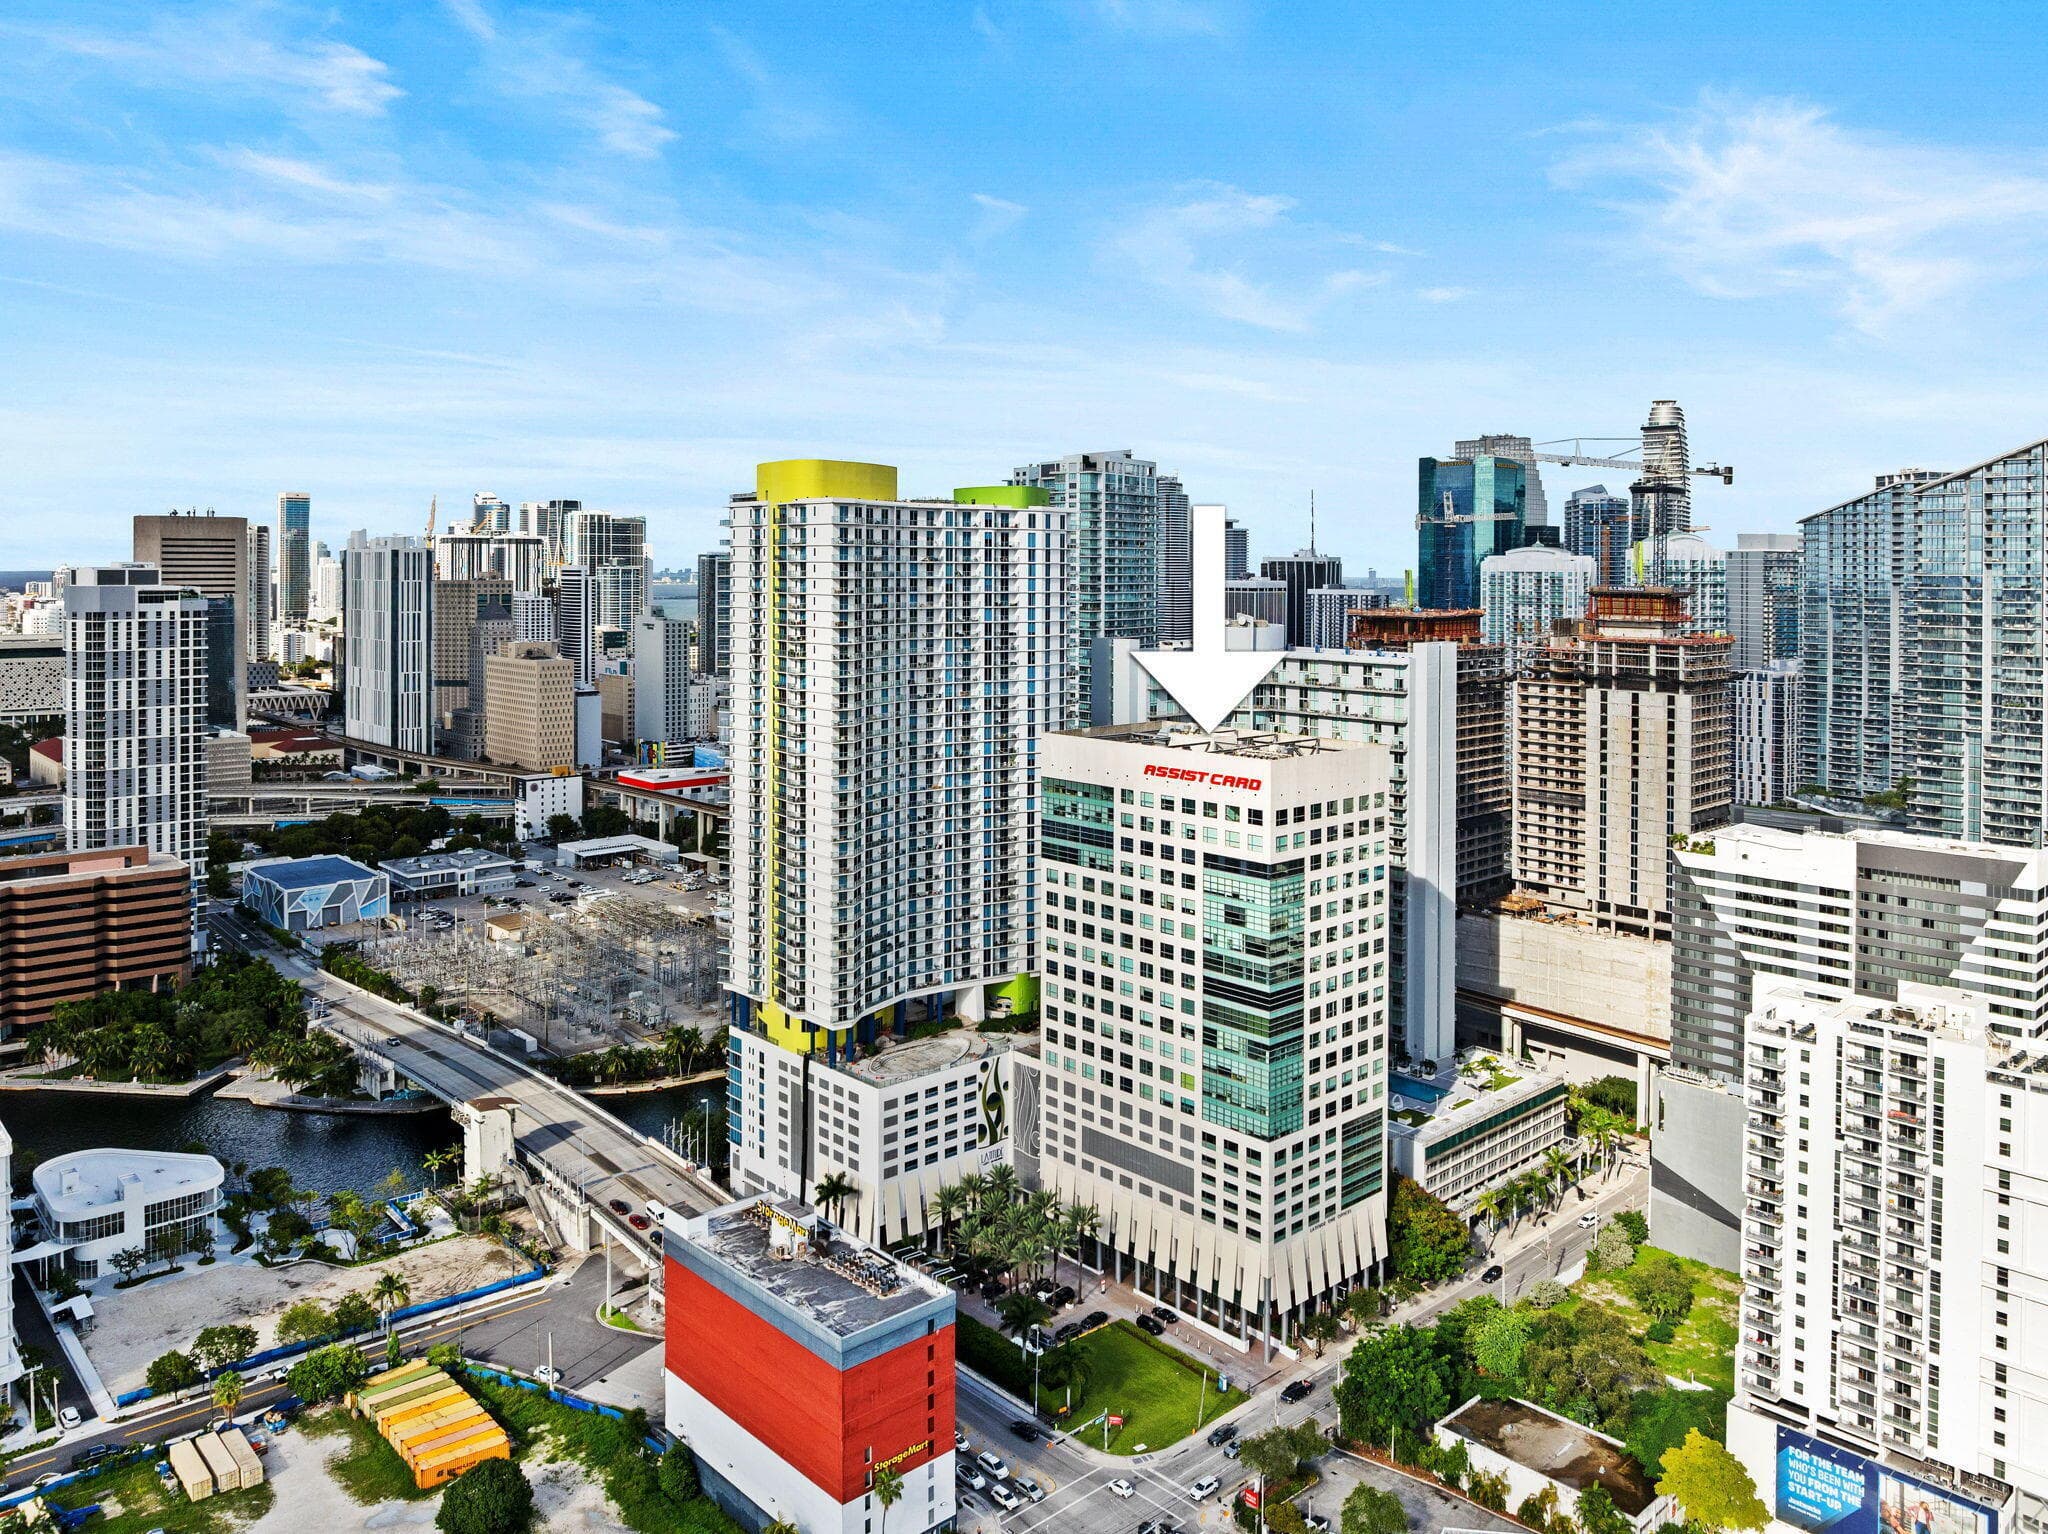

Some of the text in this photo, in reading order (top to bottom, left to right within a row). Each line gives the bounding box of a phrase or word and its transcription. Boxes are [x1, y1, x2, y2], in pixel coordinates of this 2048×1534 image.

[1143, 764, 1263, 791] ASSIST CARD
[874, 1440, 929, 1473] StorageMart
[1789, 1445, 1865, 1485] FOR THE TEAM
[1789, 1457, 1865, 1498] WHO'S BEEN WITH
[1789, 1469, 1862, 1508] YOU FROM THE
